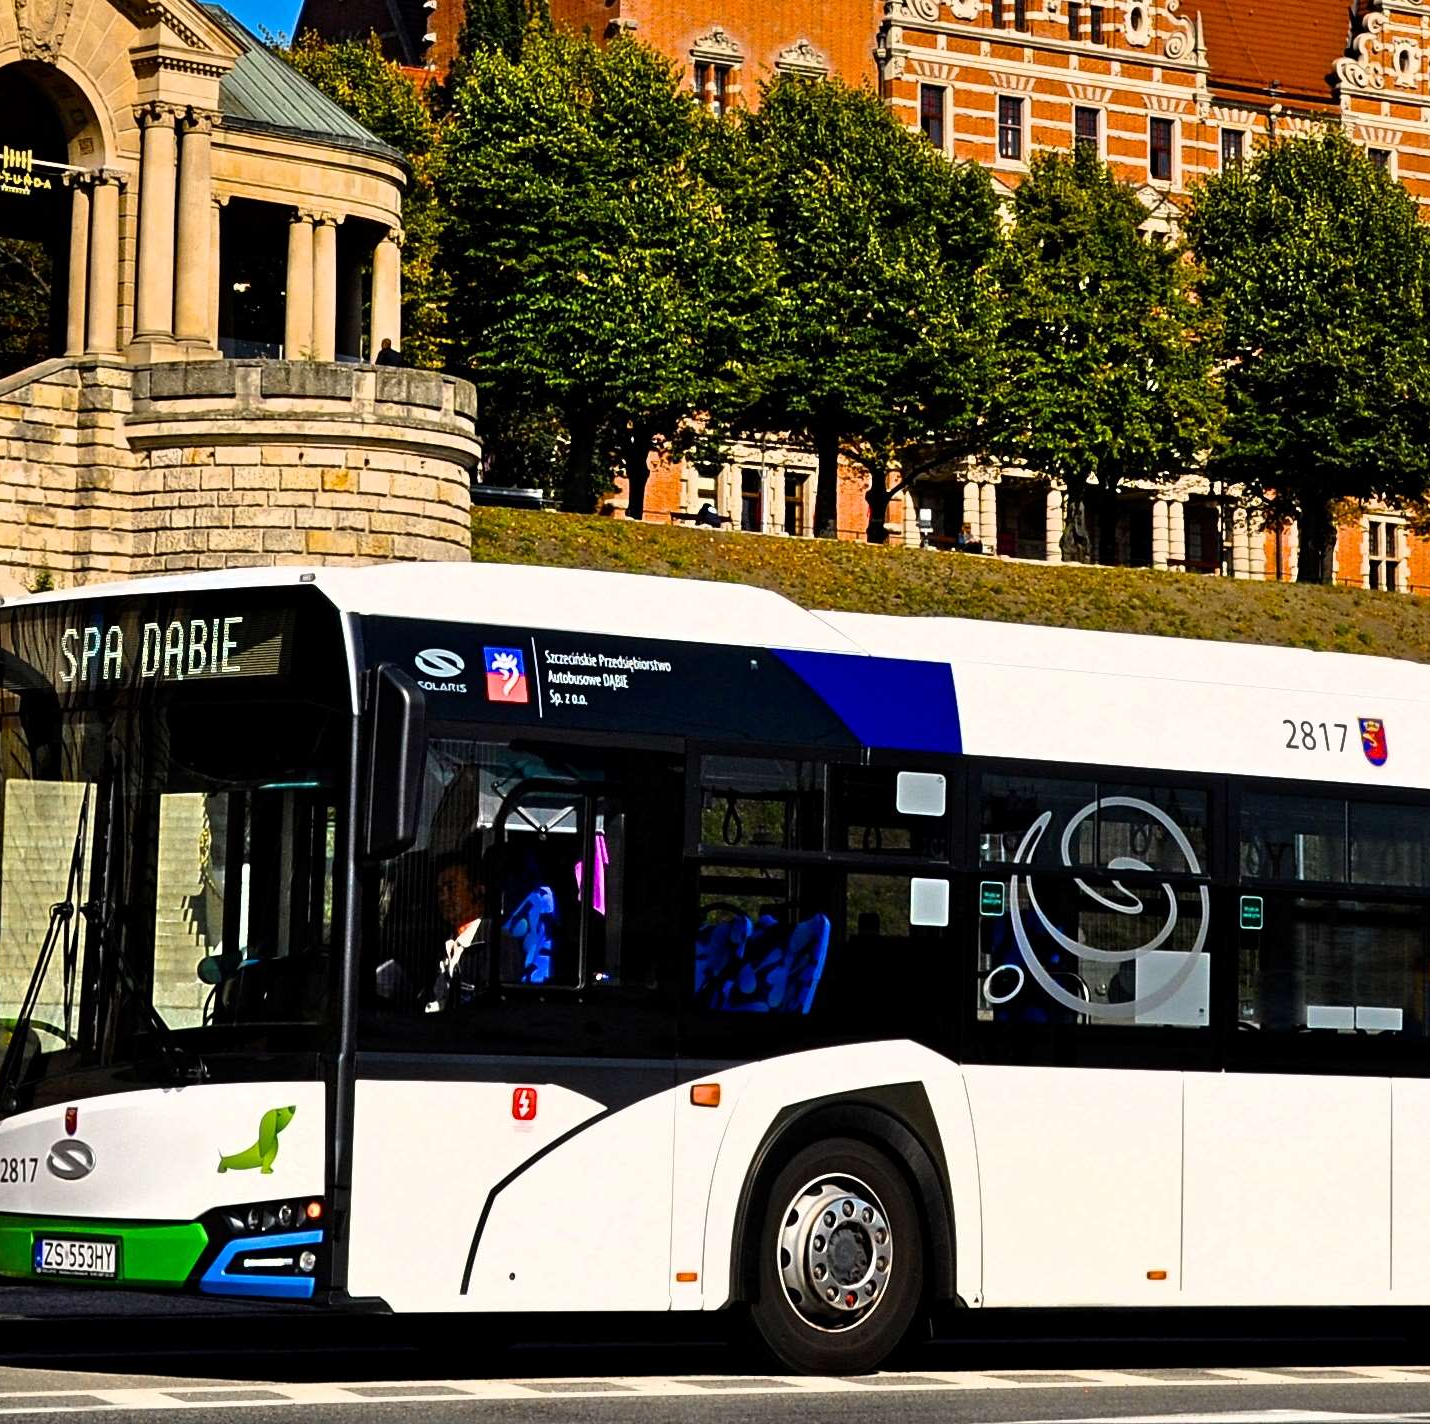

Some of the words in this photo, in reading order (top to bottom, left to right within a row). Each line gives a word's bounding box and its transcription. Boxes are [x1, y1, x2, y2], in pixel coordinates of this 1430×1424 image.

[59, 626, 123, 682] SPA
[142, 616, 243, 680] DĄBIE
[545, 650, 597, 667] Szczecińskie
[598, 654, 672, 672] Przedsiębiorstwo
[417, 680, 467, 693] SOLARIS
[548, 670, 601, 687] Autobusowe
[602, 673, 629, 690] DĄBIE
[550, 689, 563, 706] Sp.
[565, 694, 570, 704] z
[572, 694, 588, 705] o.o.
[1282, 719, 1348, 753] 2817
[0, 1158, 39, 1183] 2817
[44, 1242, 64, 1267] ZS
[70, 1243, 115, 1271] 553HY
